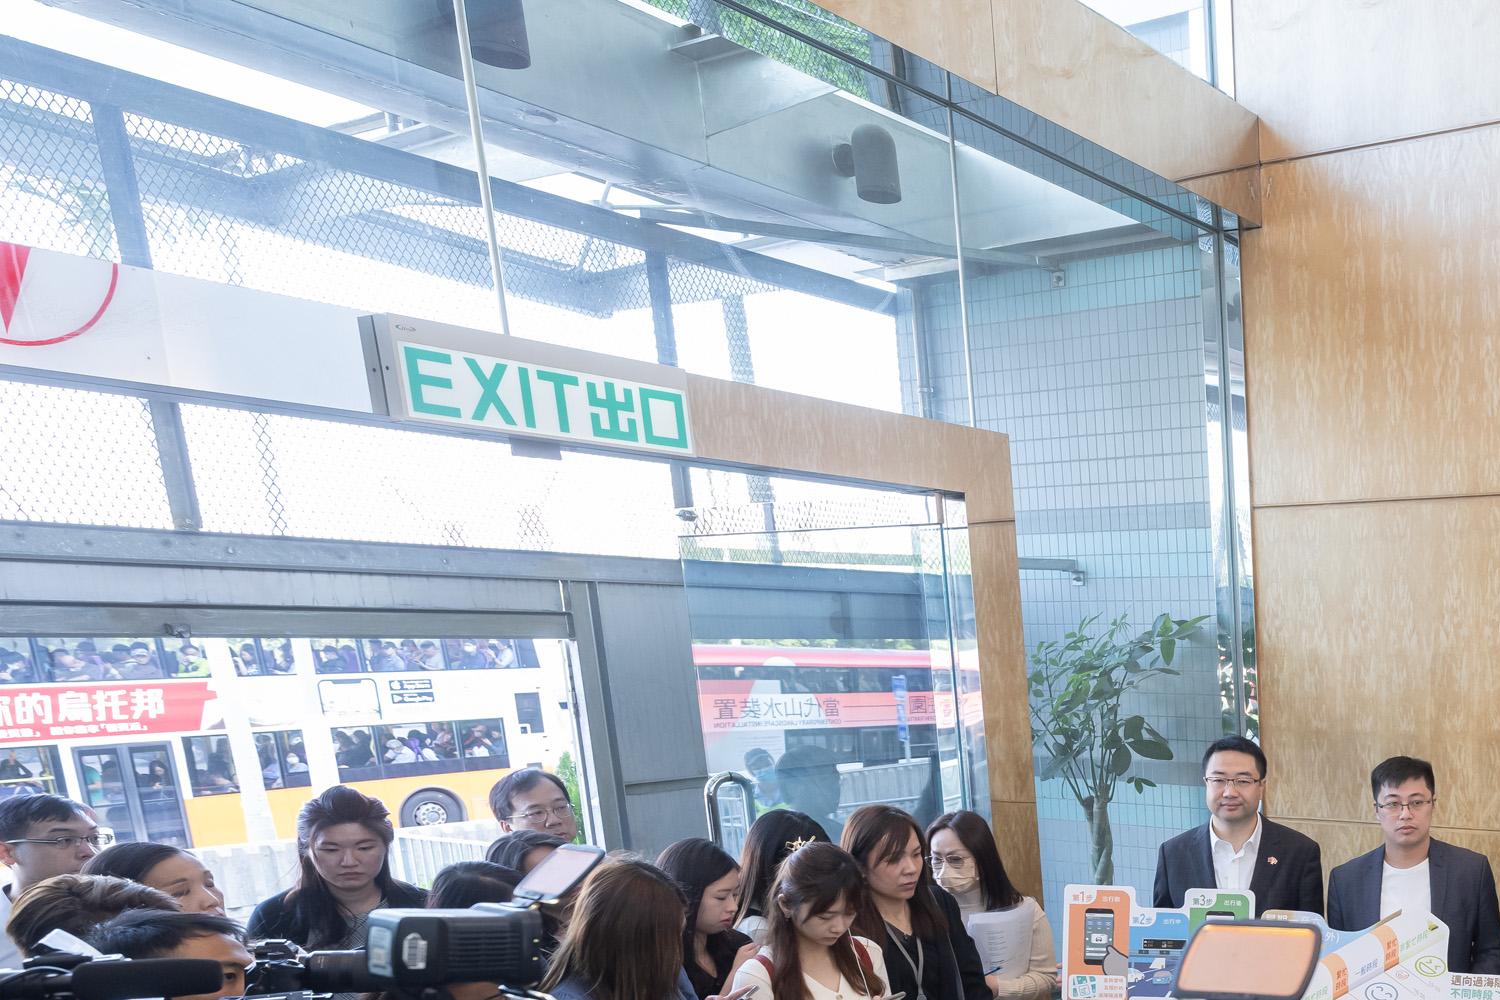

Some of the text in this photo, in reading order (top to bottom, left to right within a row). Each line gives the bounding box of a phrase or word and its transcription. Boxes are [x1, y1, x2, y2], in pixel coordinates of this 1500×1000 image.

[403, 346, 689, 449] EXIT 出口
[1450, 988, 1494, 1000] 不同時段
